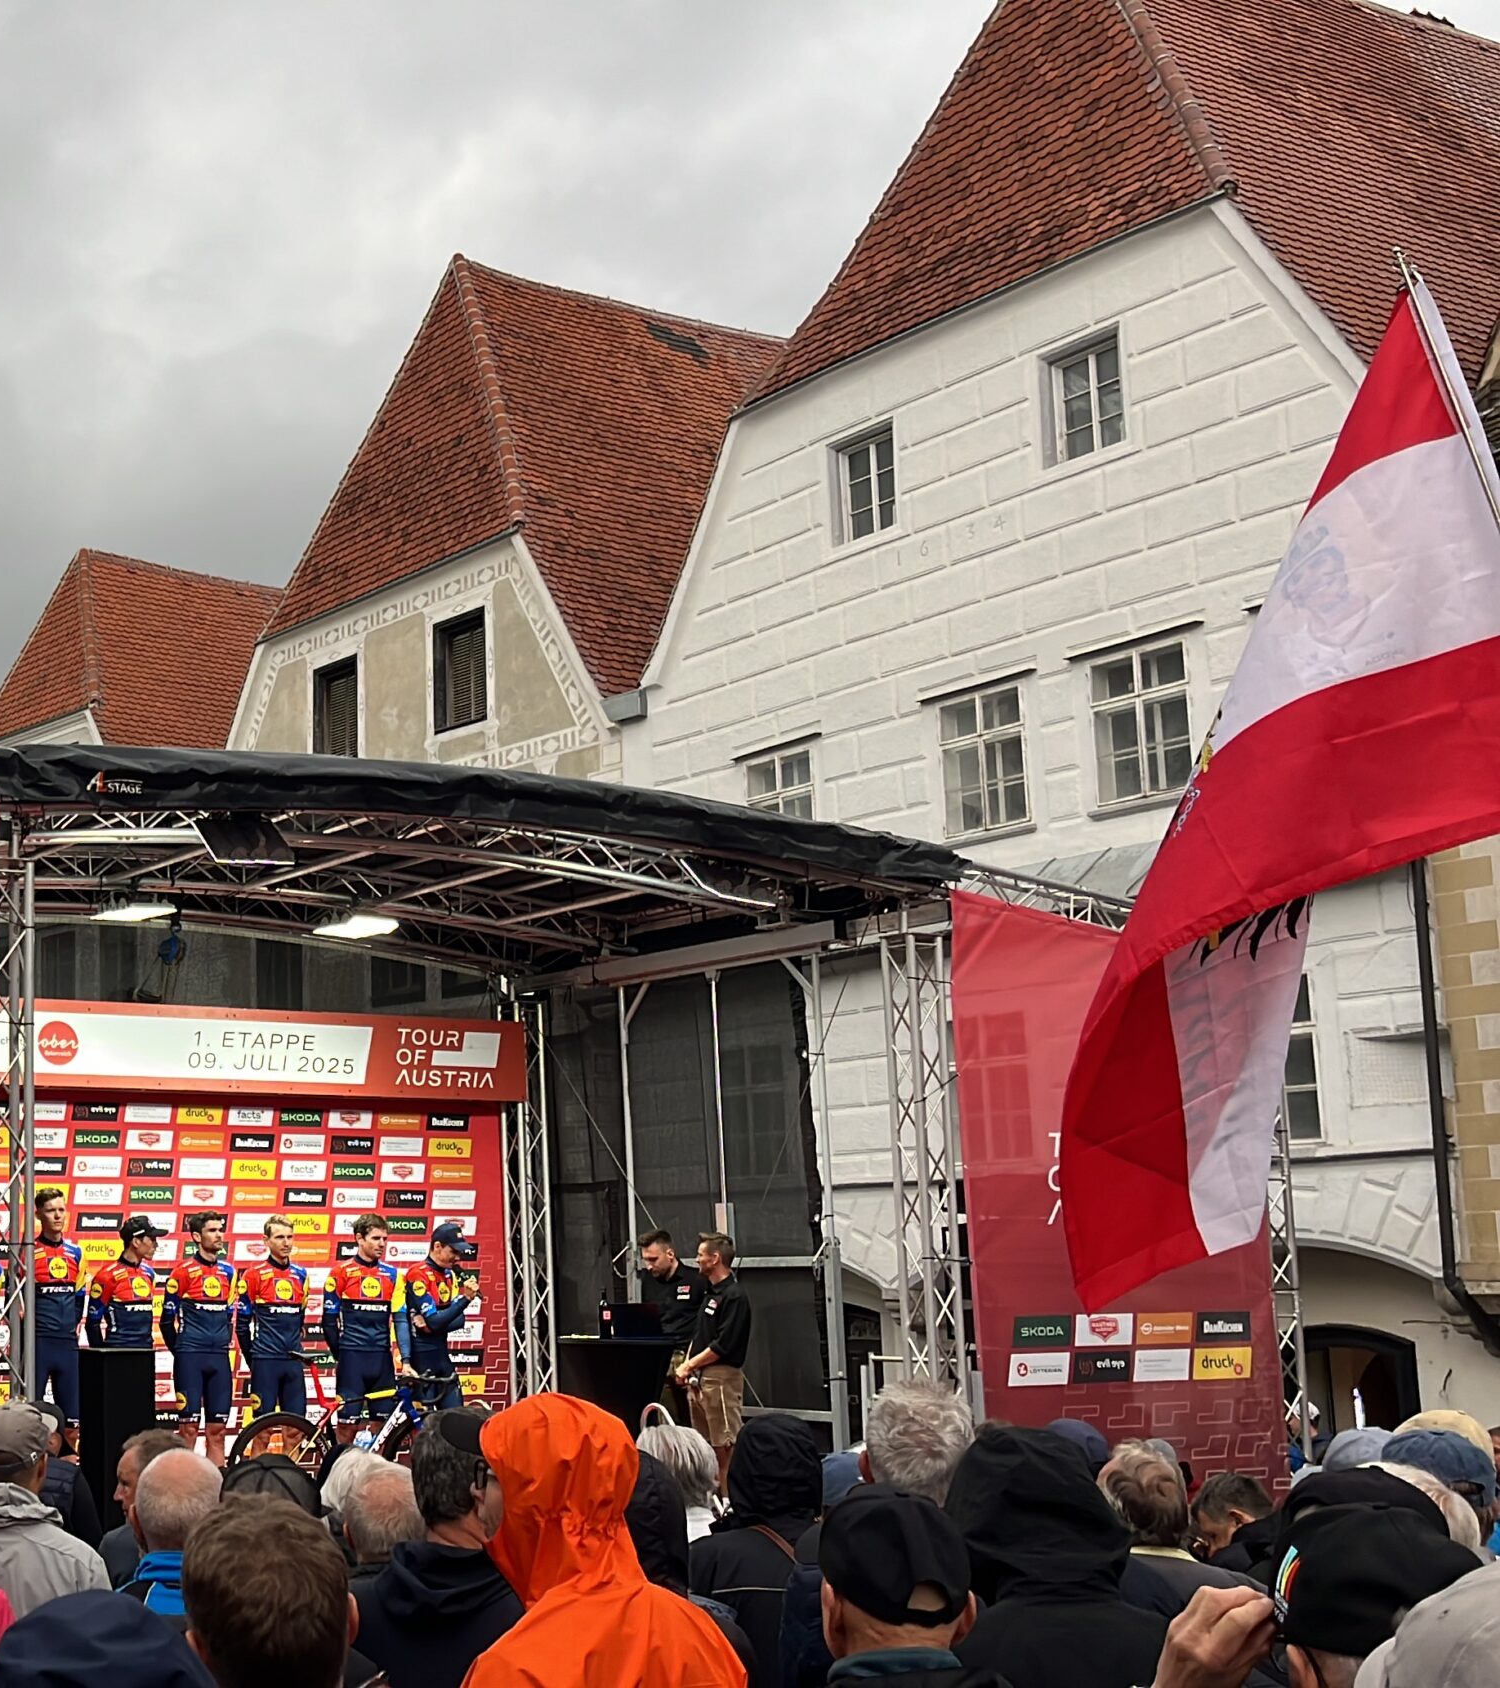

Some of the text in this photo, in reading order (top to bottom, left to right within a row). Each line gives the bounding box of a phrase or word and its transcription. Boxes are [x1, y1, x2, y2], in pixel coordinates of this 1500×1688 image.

[108, 782, 143, 794] STAGE
[193, 1031, 316, 1051] 1. ETAPPE
[398, 1028, 459, 1047] TOUR
[188, 1052, 355, 1075] 09. JULI 2025
[396, 1049, 426, 1066] OF
[395, 1069, 494, 1089] AUSTRIA
[352, 1303, 389, 1312] TREK
[1201, 1355, 1235, 1370] druck
